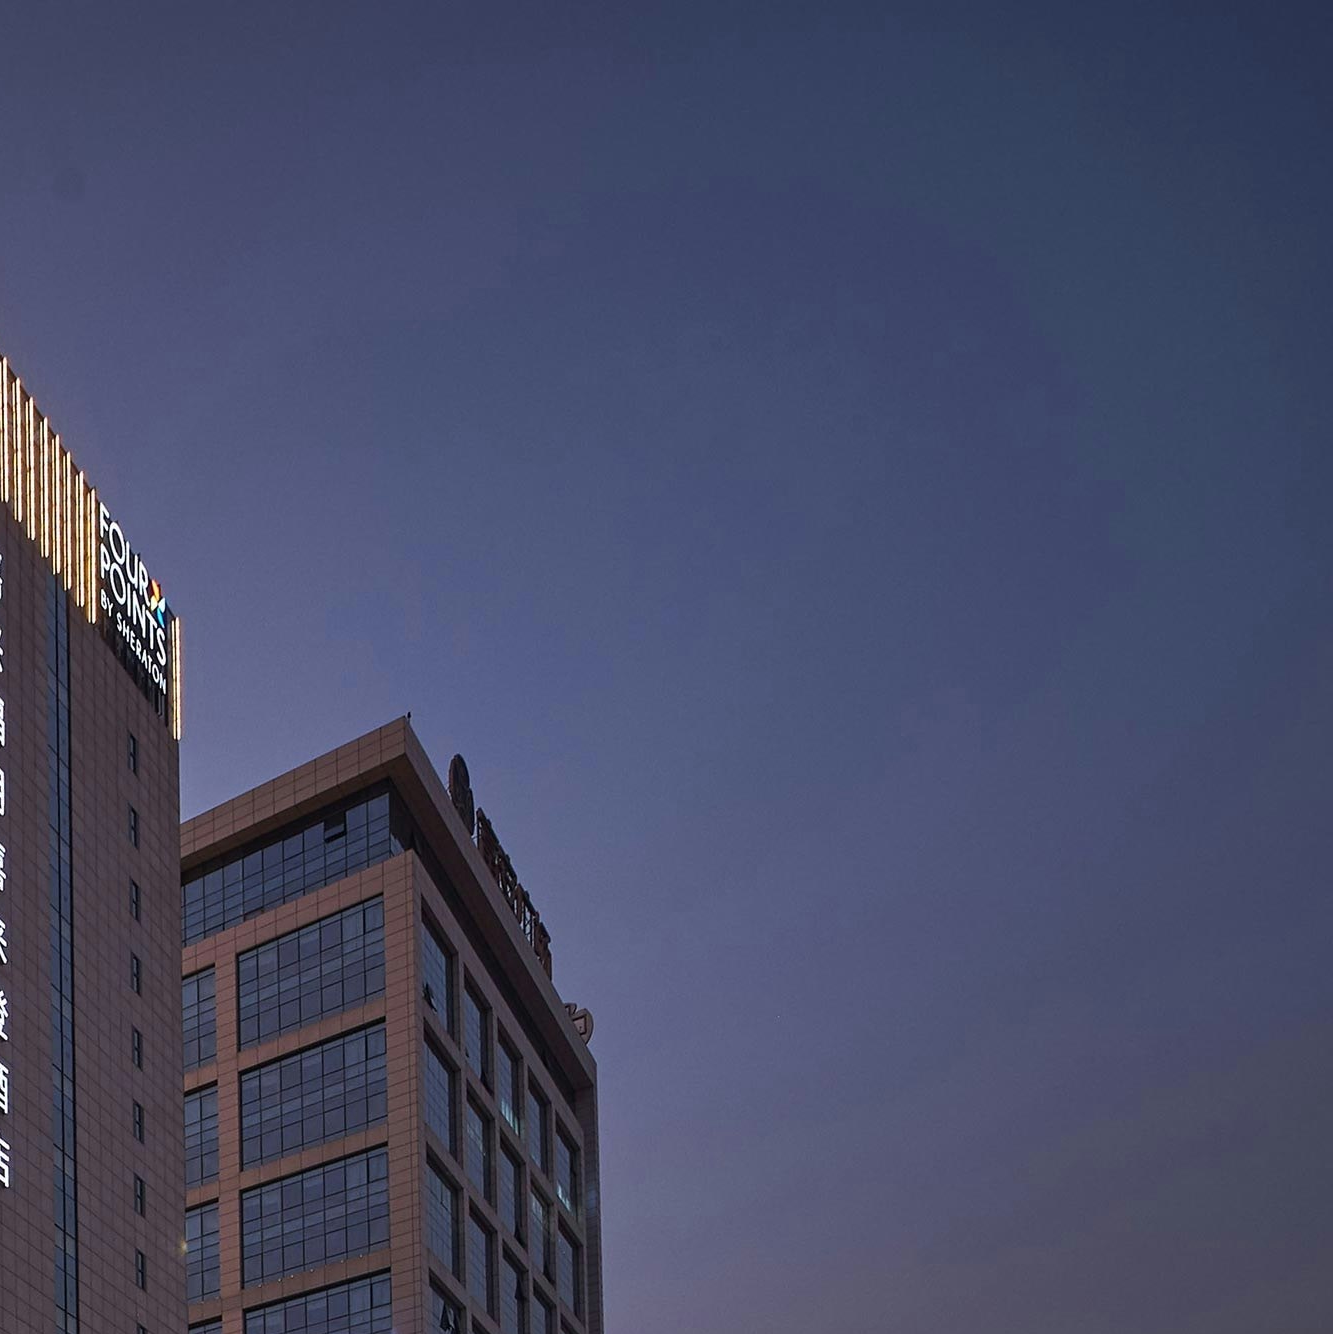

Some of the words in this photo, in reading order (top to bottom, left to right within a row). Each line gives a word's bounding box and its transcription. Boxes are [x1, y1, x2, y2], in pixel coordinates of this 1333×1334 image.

[99, 501, 151, 607] FOUR
[100, 542, 167, 667] POINTS
[100, 588, 114, 618] BY
[116, 610, 167, 695] SHERATON
